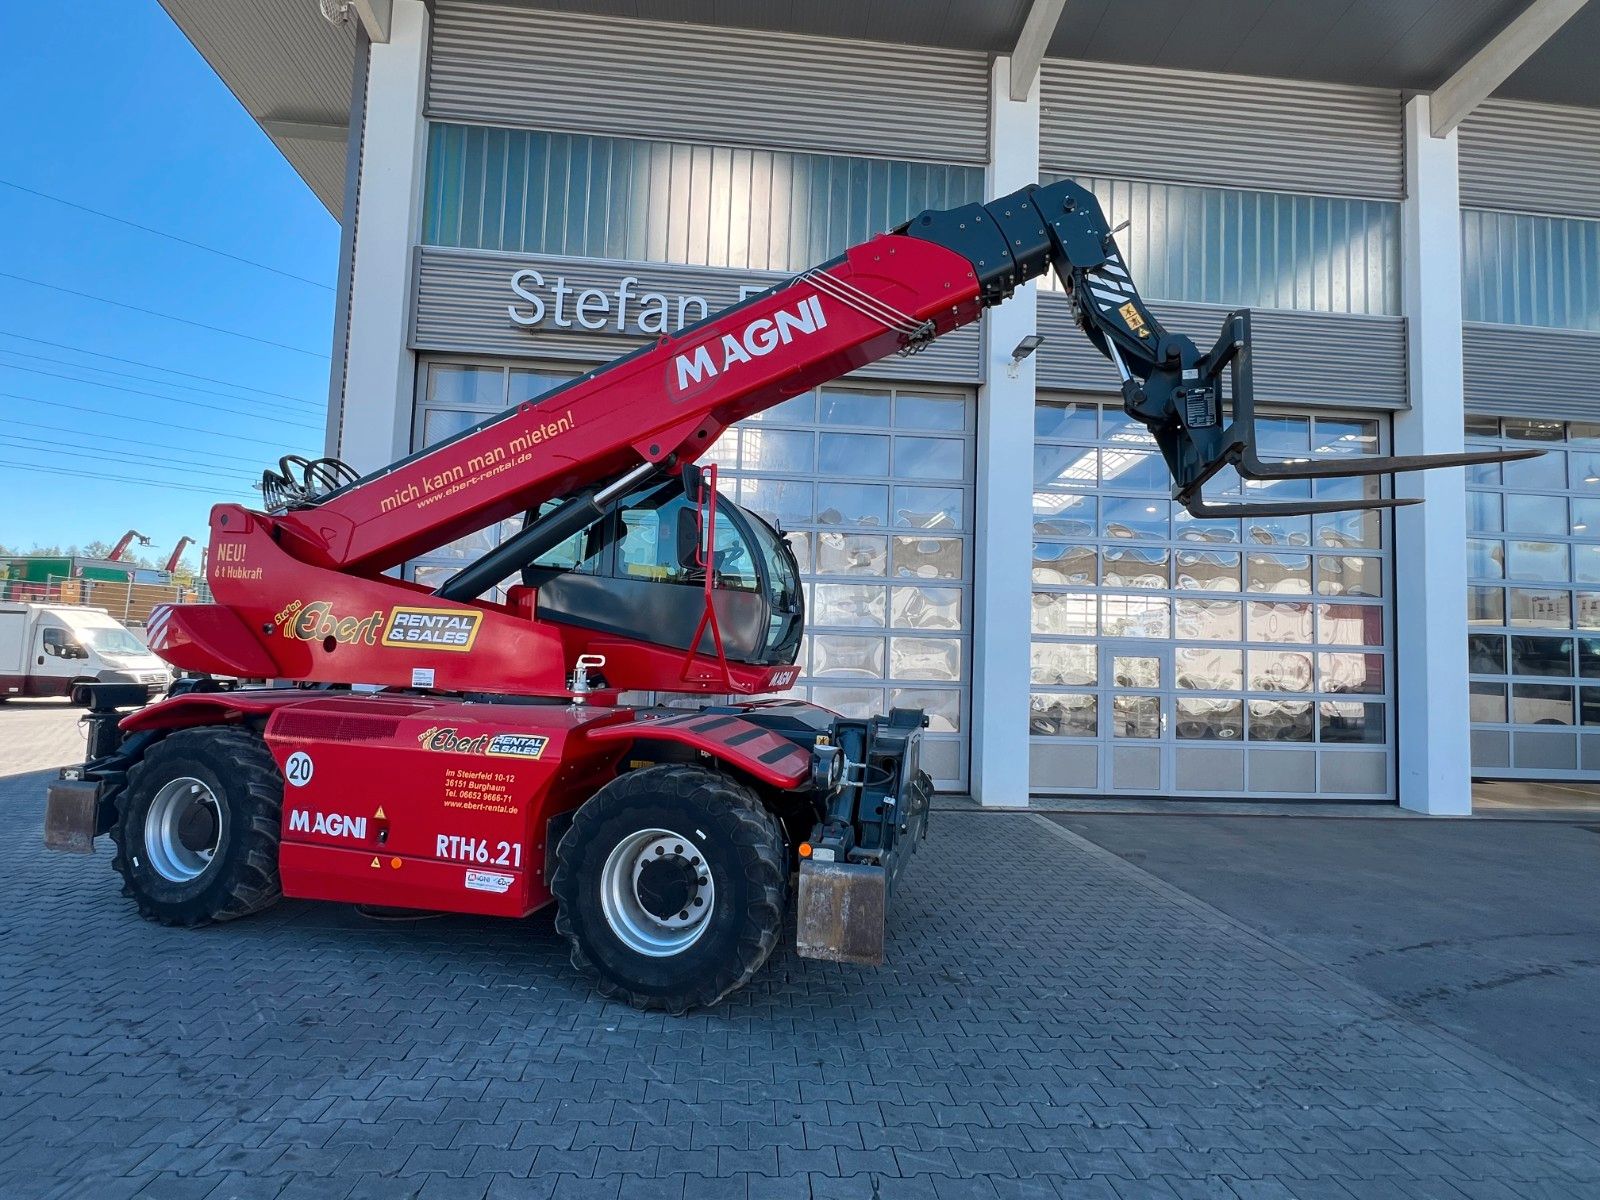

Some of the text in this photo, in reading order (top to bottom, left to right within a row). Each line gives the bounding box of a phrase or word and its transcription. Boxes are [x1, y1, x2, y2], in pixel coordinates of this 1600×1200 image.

[507, 269, 709, 334] Stefan
[675, 295, 828, 391] MAGNI
[380, 410, 575, 513] mich kann man mieten!
[416, 452, 533, 509] www.ebert-rental.de
[217, 543, 247, 562] NEU!
[214, 565, 263, 580] 6 t Hubkraft
[274, 599, 302, 626] Stefan
[295, 600, 385, 646] Ebert
[394, 613, 472, 630] RENTAL
[389, 628, 469, 645] & SALES
[430, 727, 489, 756] Ebert
[490, 745, 540, 756] & SALES
[493, 735, 542, 747] RENTAL
[289, 757, 310, 780] 20
[456, 769, 493, 781] Steierfeld
[494, 773, 515, 783] 10-12
[445, 779, 506, 793] 36151 Burghaun
[445, 788, 458, 798] Tel.
[459, 791, 482, 800] 06652
[443, 801, 519, 815] www.ebert-rental.de
[289, 809, 367, 839] MAGNI
[436, 833, 522, 867] RTH6.21
